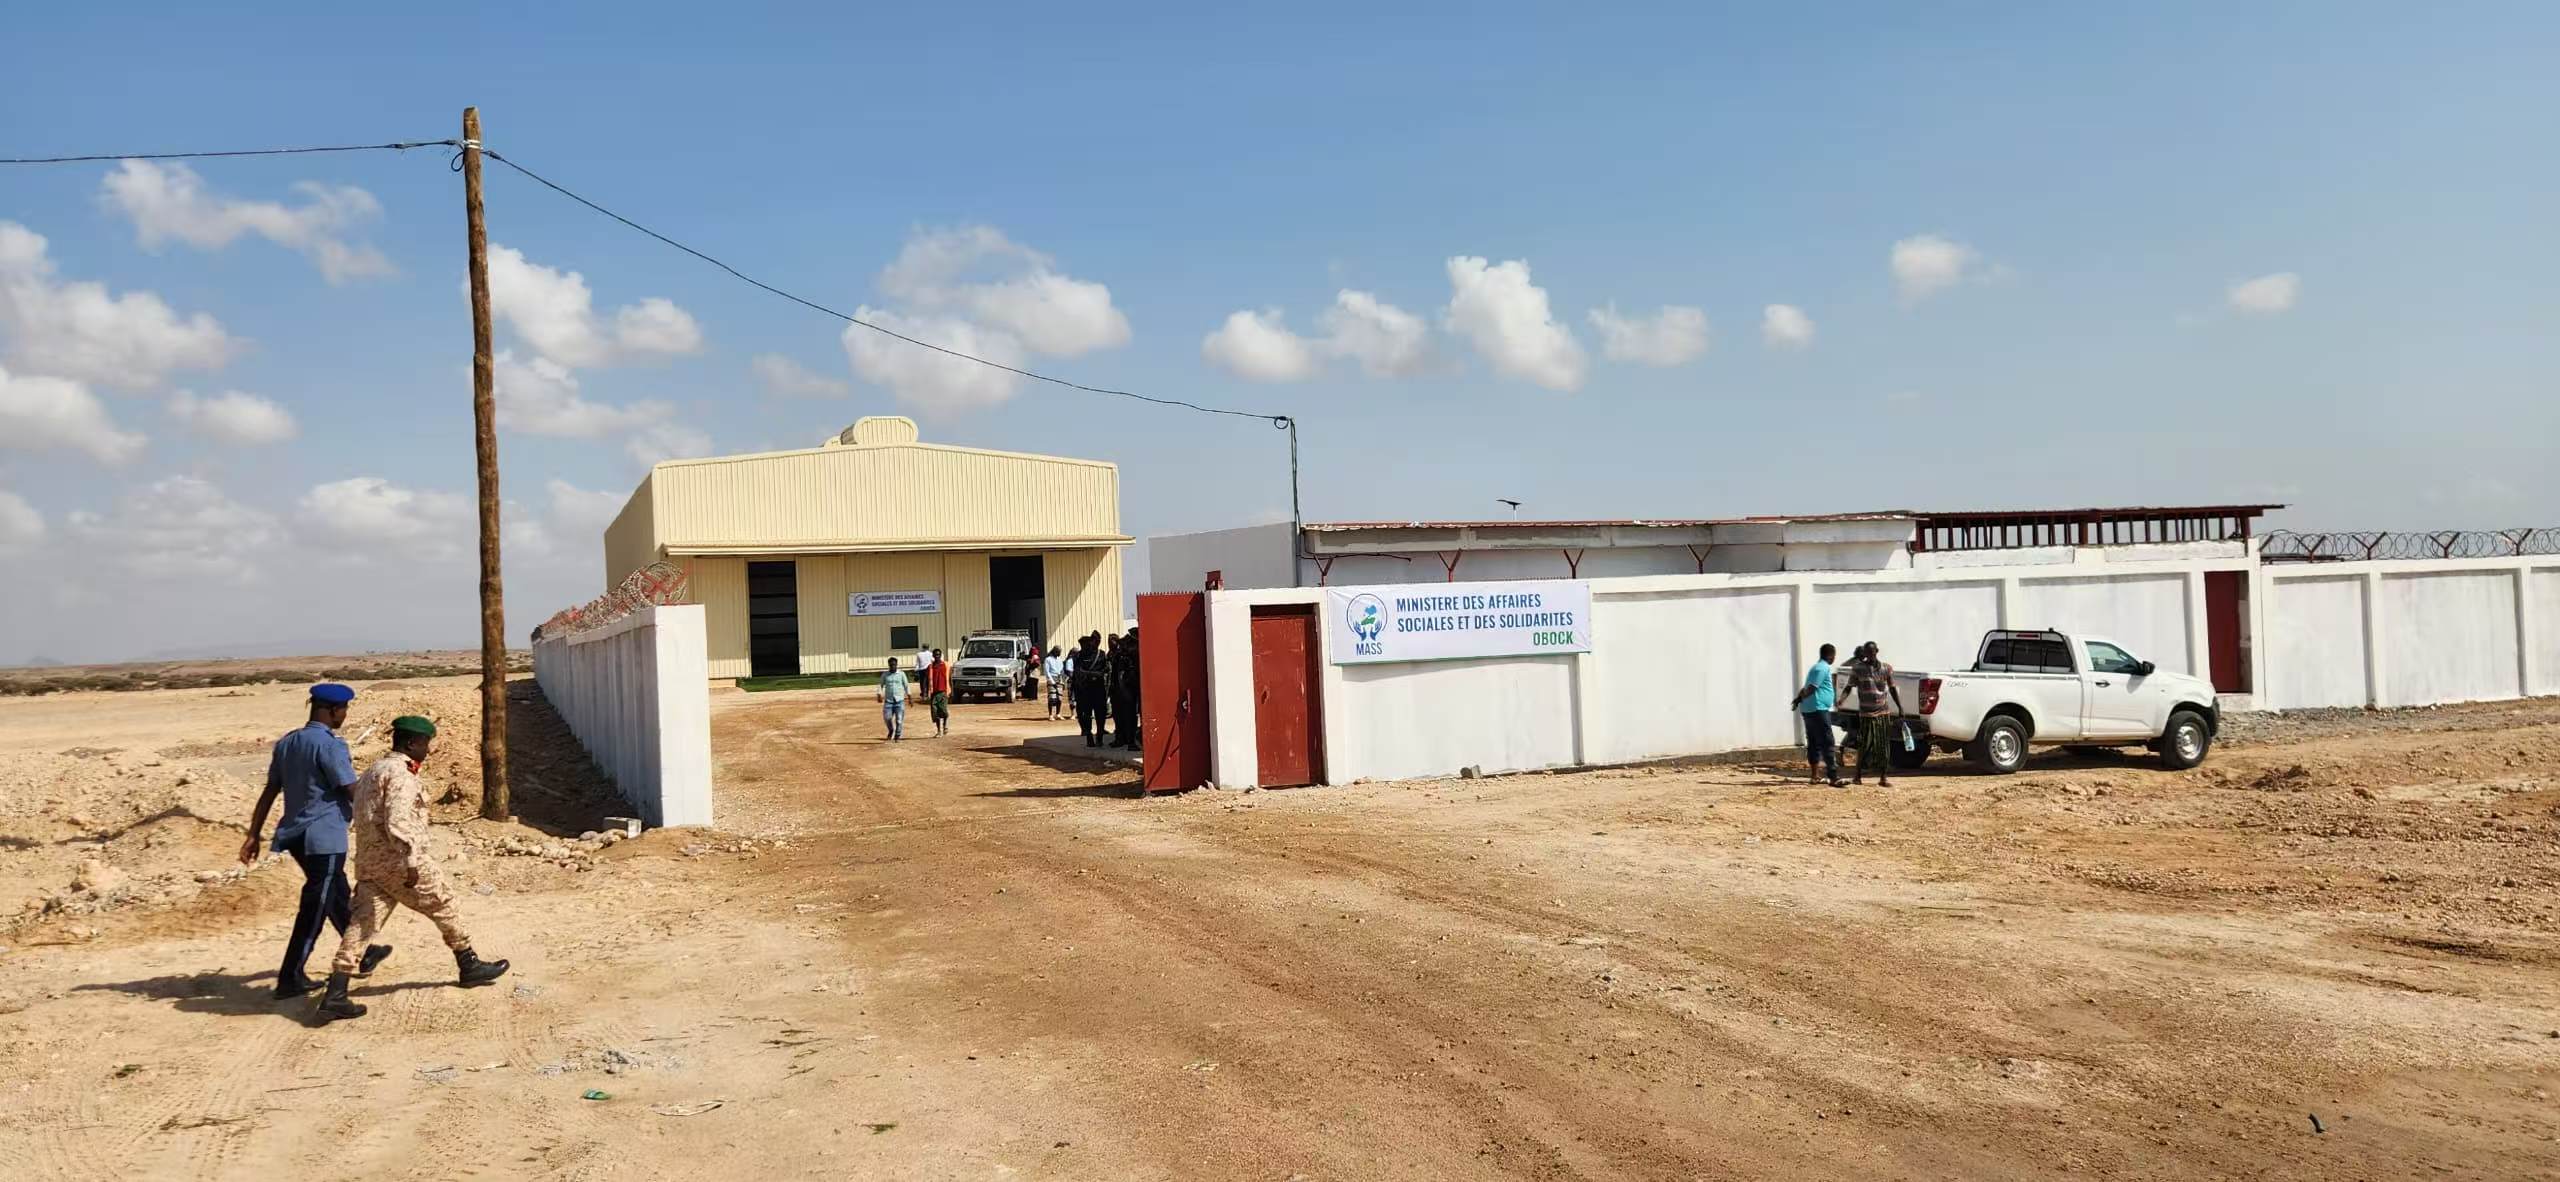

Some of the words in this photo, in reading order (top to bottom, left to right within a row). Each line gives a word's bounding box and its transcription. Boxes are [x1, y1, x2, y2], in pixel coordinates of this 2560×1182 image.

[1396, 597, 1459, 612] MINISTERE
[1463, 595, 1485, 610] DES
[1488, 593, 1541, 609] AFFAIRES
[1398, 616, 1454, 632] SOCIALES
[1458, 615, 1470, 630] ET
[1474, 615, 1496, 629] DES
[1500, 611, 1573, 628] SOLIDARITES
[1533, 631, 1574, 646] OBOCK
[1356, 642, 1383, 656] MASS
